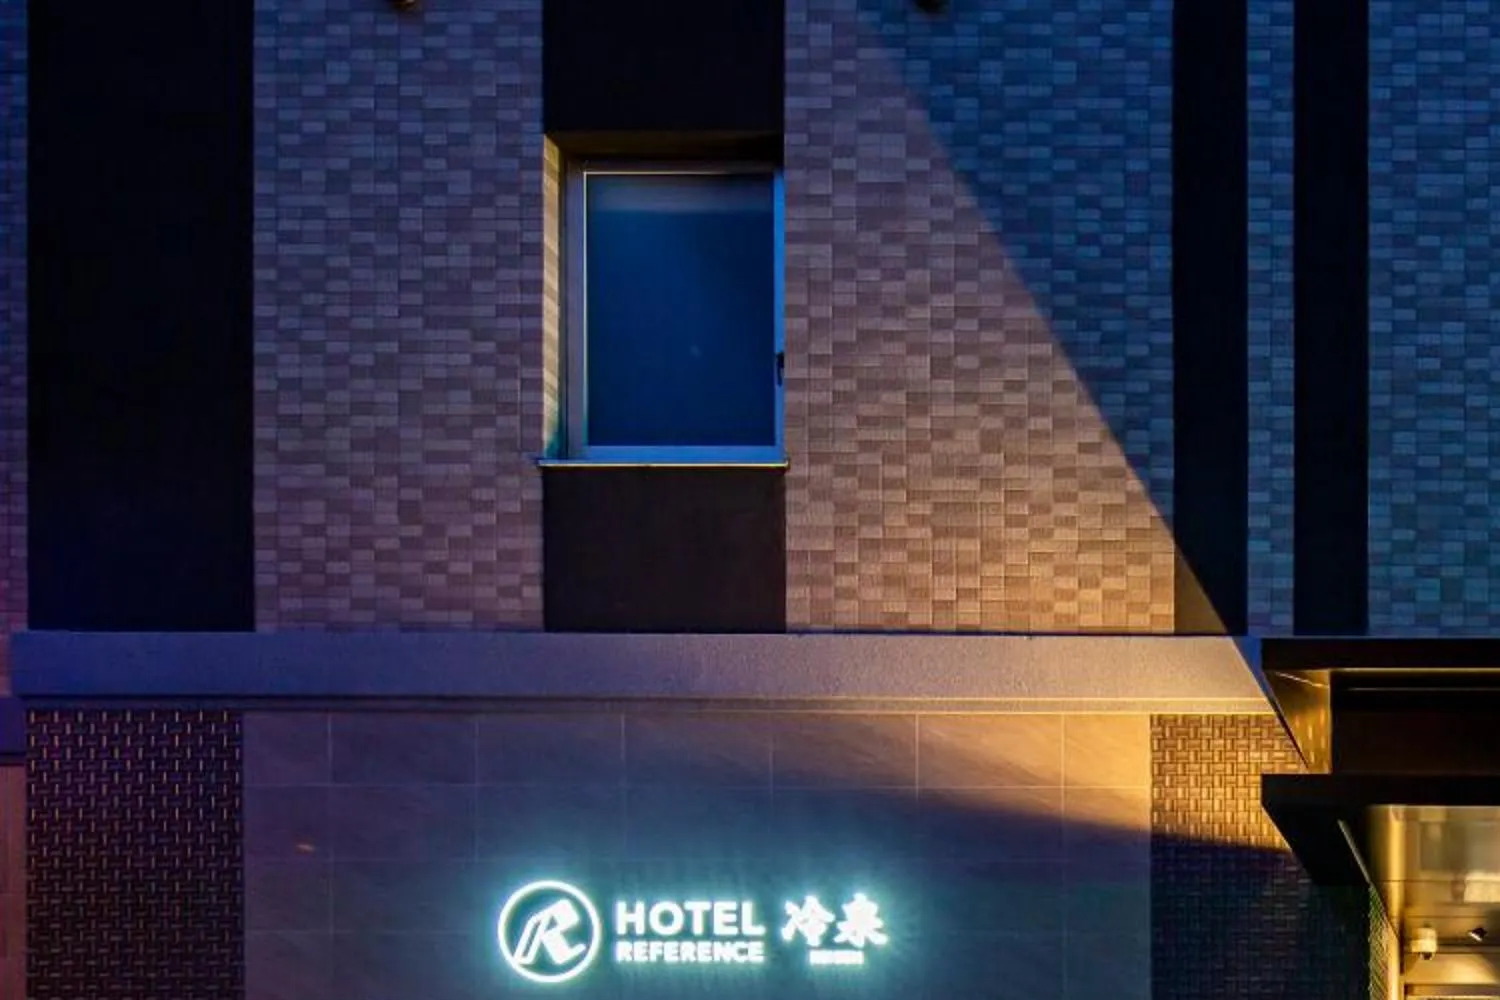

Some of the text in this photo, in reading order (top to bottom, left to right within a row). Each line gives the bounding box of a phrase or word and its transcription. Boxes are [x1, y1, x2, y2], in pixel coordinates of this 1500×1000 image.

[616, 892, 889, 949] HOTEL 冷泉
[616, 940, 765, 963] REFERENCE
